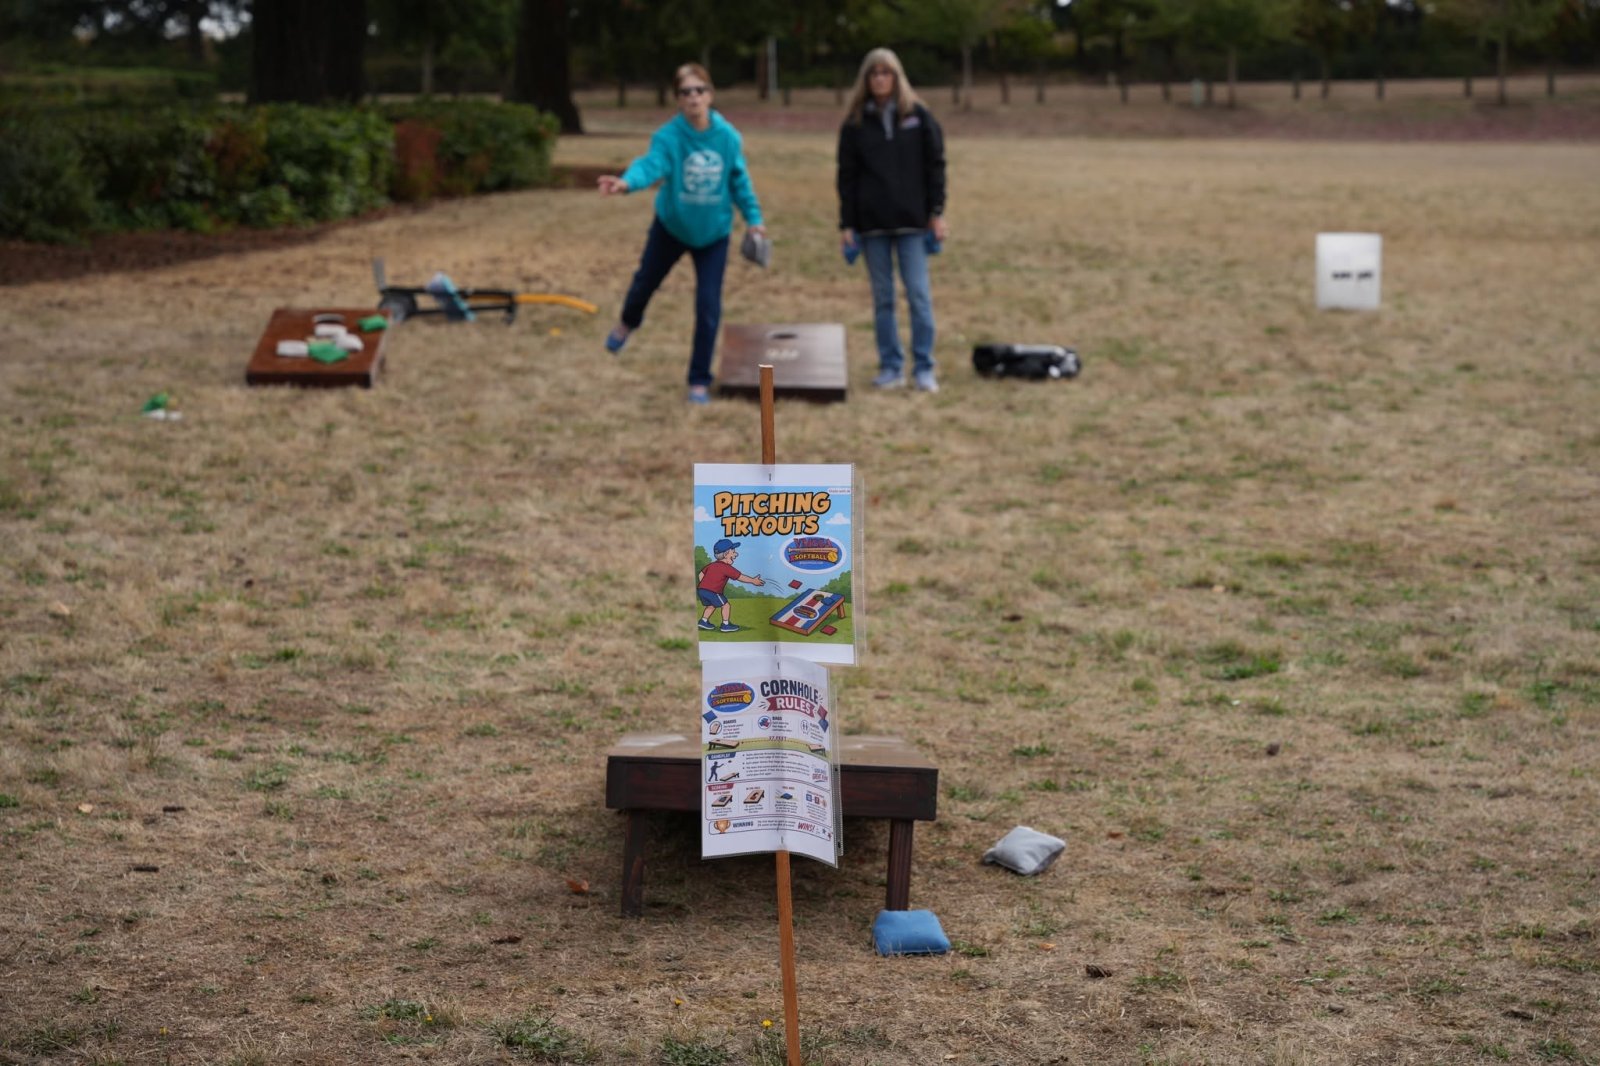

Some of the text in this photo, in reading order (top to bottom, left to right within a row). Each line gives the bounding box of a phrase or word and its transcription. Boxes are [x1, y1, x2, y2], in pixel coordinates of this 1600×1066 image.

[714, 491, 831, 517] PITCHING
[721, 515, 820, 537] TRYOUTS
[794, 553, 828, 561] SOFTBALL
[716, 696, 743, 705] SOFTBALL
[760, 679, 819, 705] CORNHOLE
[775, 697, 812, 716] RULES
[733, 820, 754, 828] WINNING
